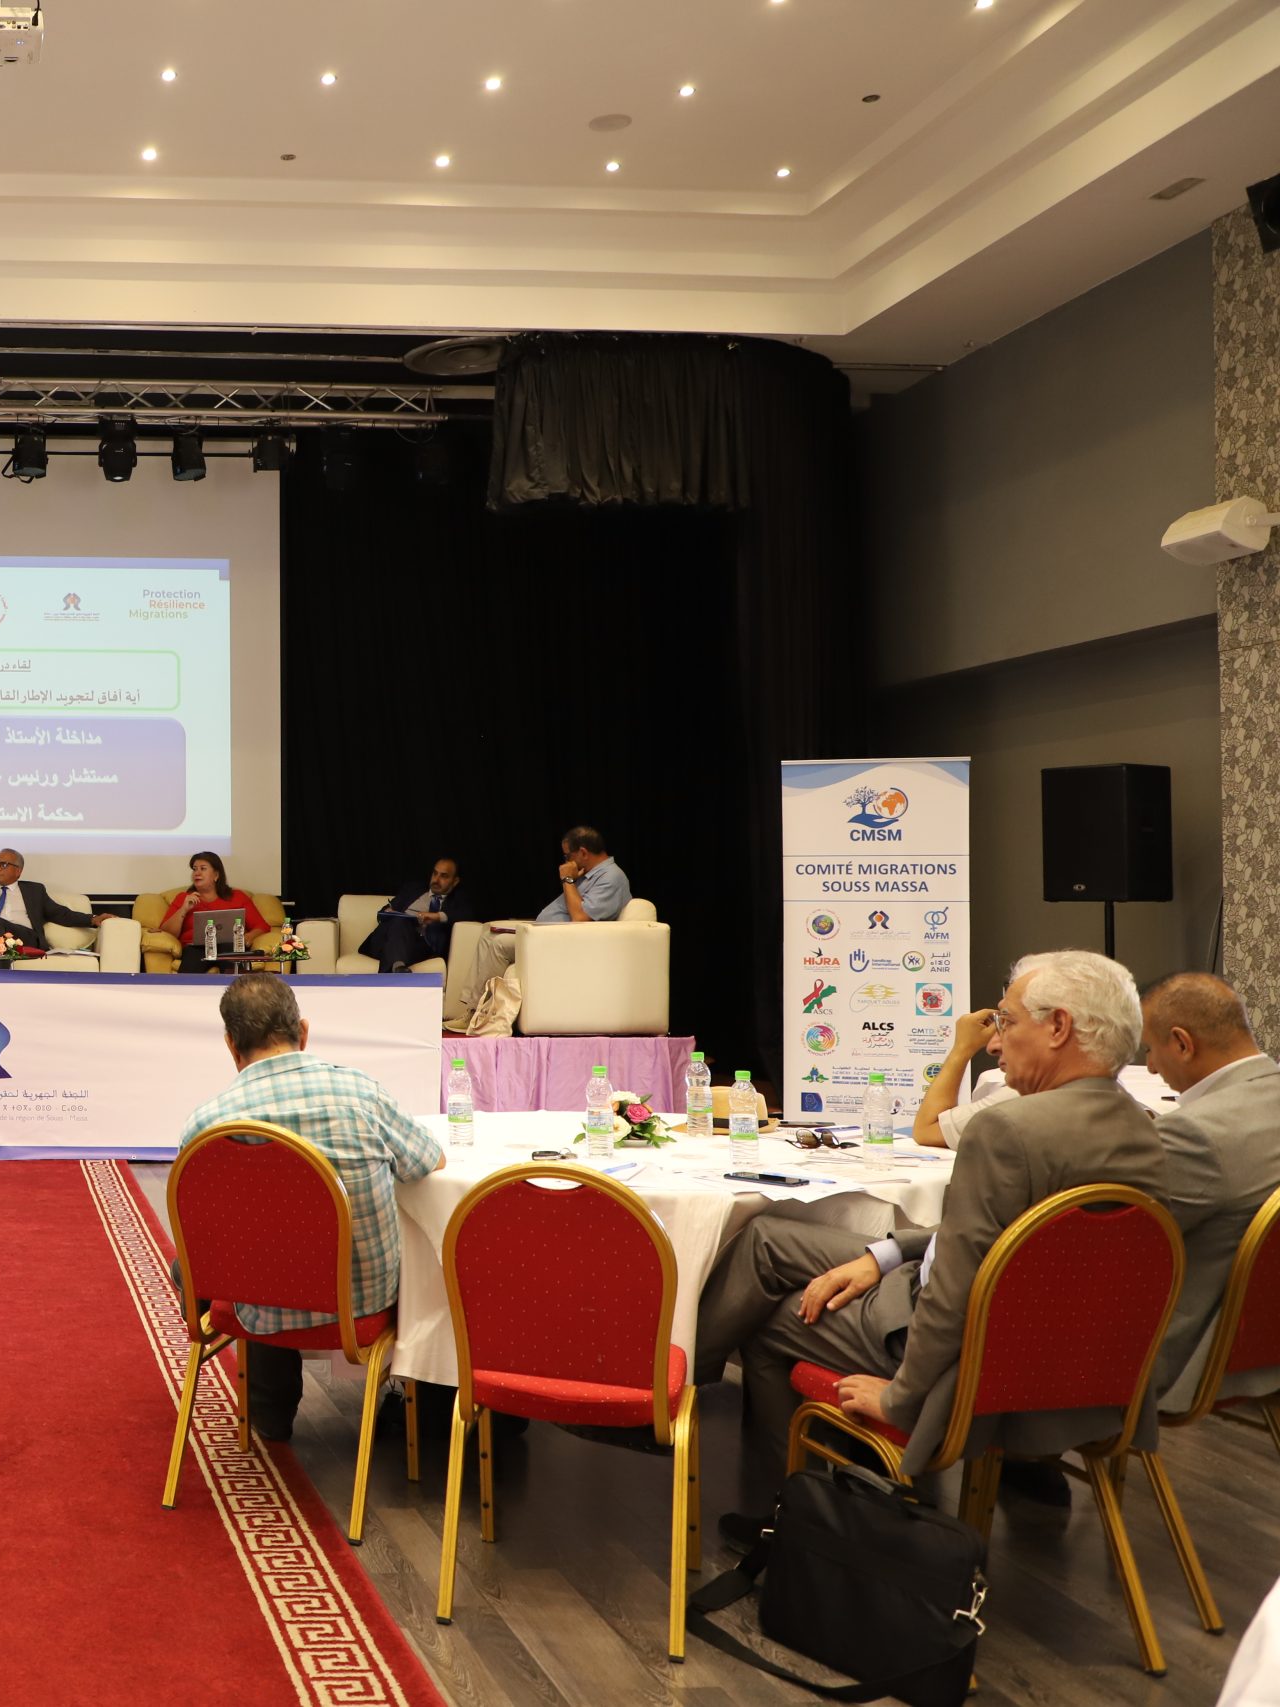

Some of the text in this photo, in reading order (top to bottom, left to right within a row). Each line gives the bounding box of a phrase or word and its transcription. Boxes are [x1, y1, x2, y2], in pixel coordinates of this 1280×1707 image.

[143, 589, 201, 599] Protection
[149, 599, 206, 609] Résilience
[129, 609, 189, 621] Migrations
[12, 659, 32, 671] لقاء
[55, 727, 102, 745] مداخلة
[62, 767, 119, 787] مستشار
[37, 803, 84, 822] محكمة
[849, 829, 902, 842] CMSM
[795, 860, 958, 876] COMITÉ MIGRATIONS
[821, 880, 929, 893] SOUSS MASSA
[923, 932, 950, 940] AVFM
[862, 1021, 895, 1031] ALCS
